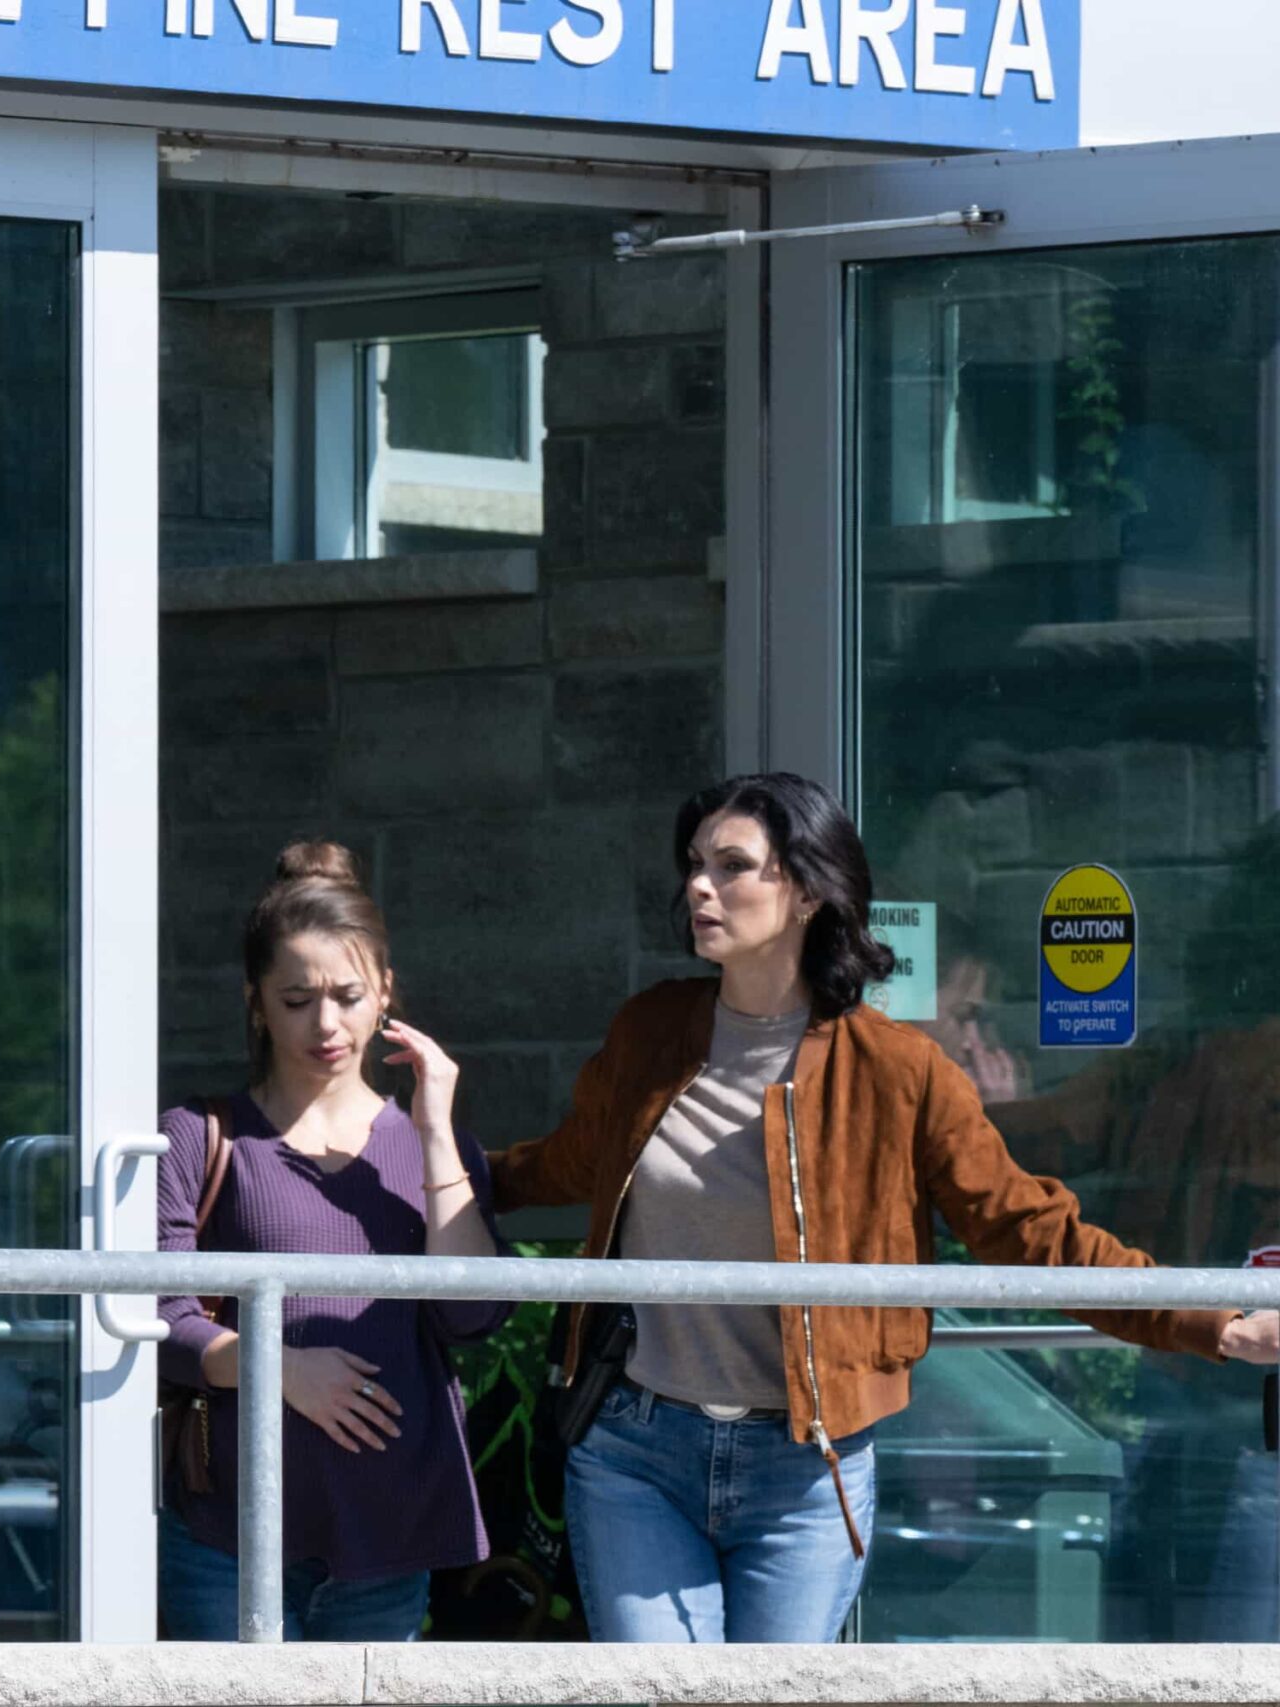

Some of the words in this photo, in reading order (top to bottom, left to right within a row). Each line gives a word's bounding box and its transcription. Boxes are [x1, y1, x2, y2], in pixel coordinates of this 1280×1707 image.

[1055, 897, 1121, 912] AUTOMATIC
[869, 907, 920, 927] MOKING
[1050, 920, 1125, 940] CAUTION
[1071, 950, 1104, 964] DOOR
[1045, 1000, 1090, 1013] ACTIVATE
[1092, 1000, 1129, 1013] SWITCH
[1058, 1018, 1071, 1031] TO
[1073, 1018, 1117, 1032] OPERATE
